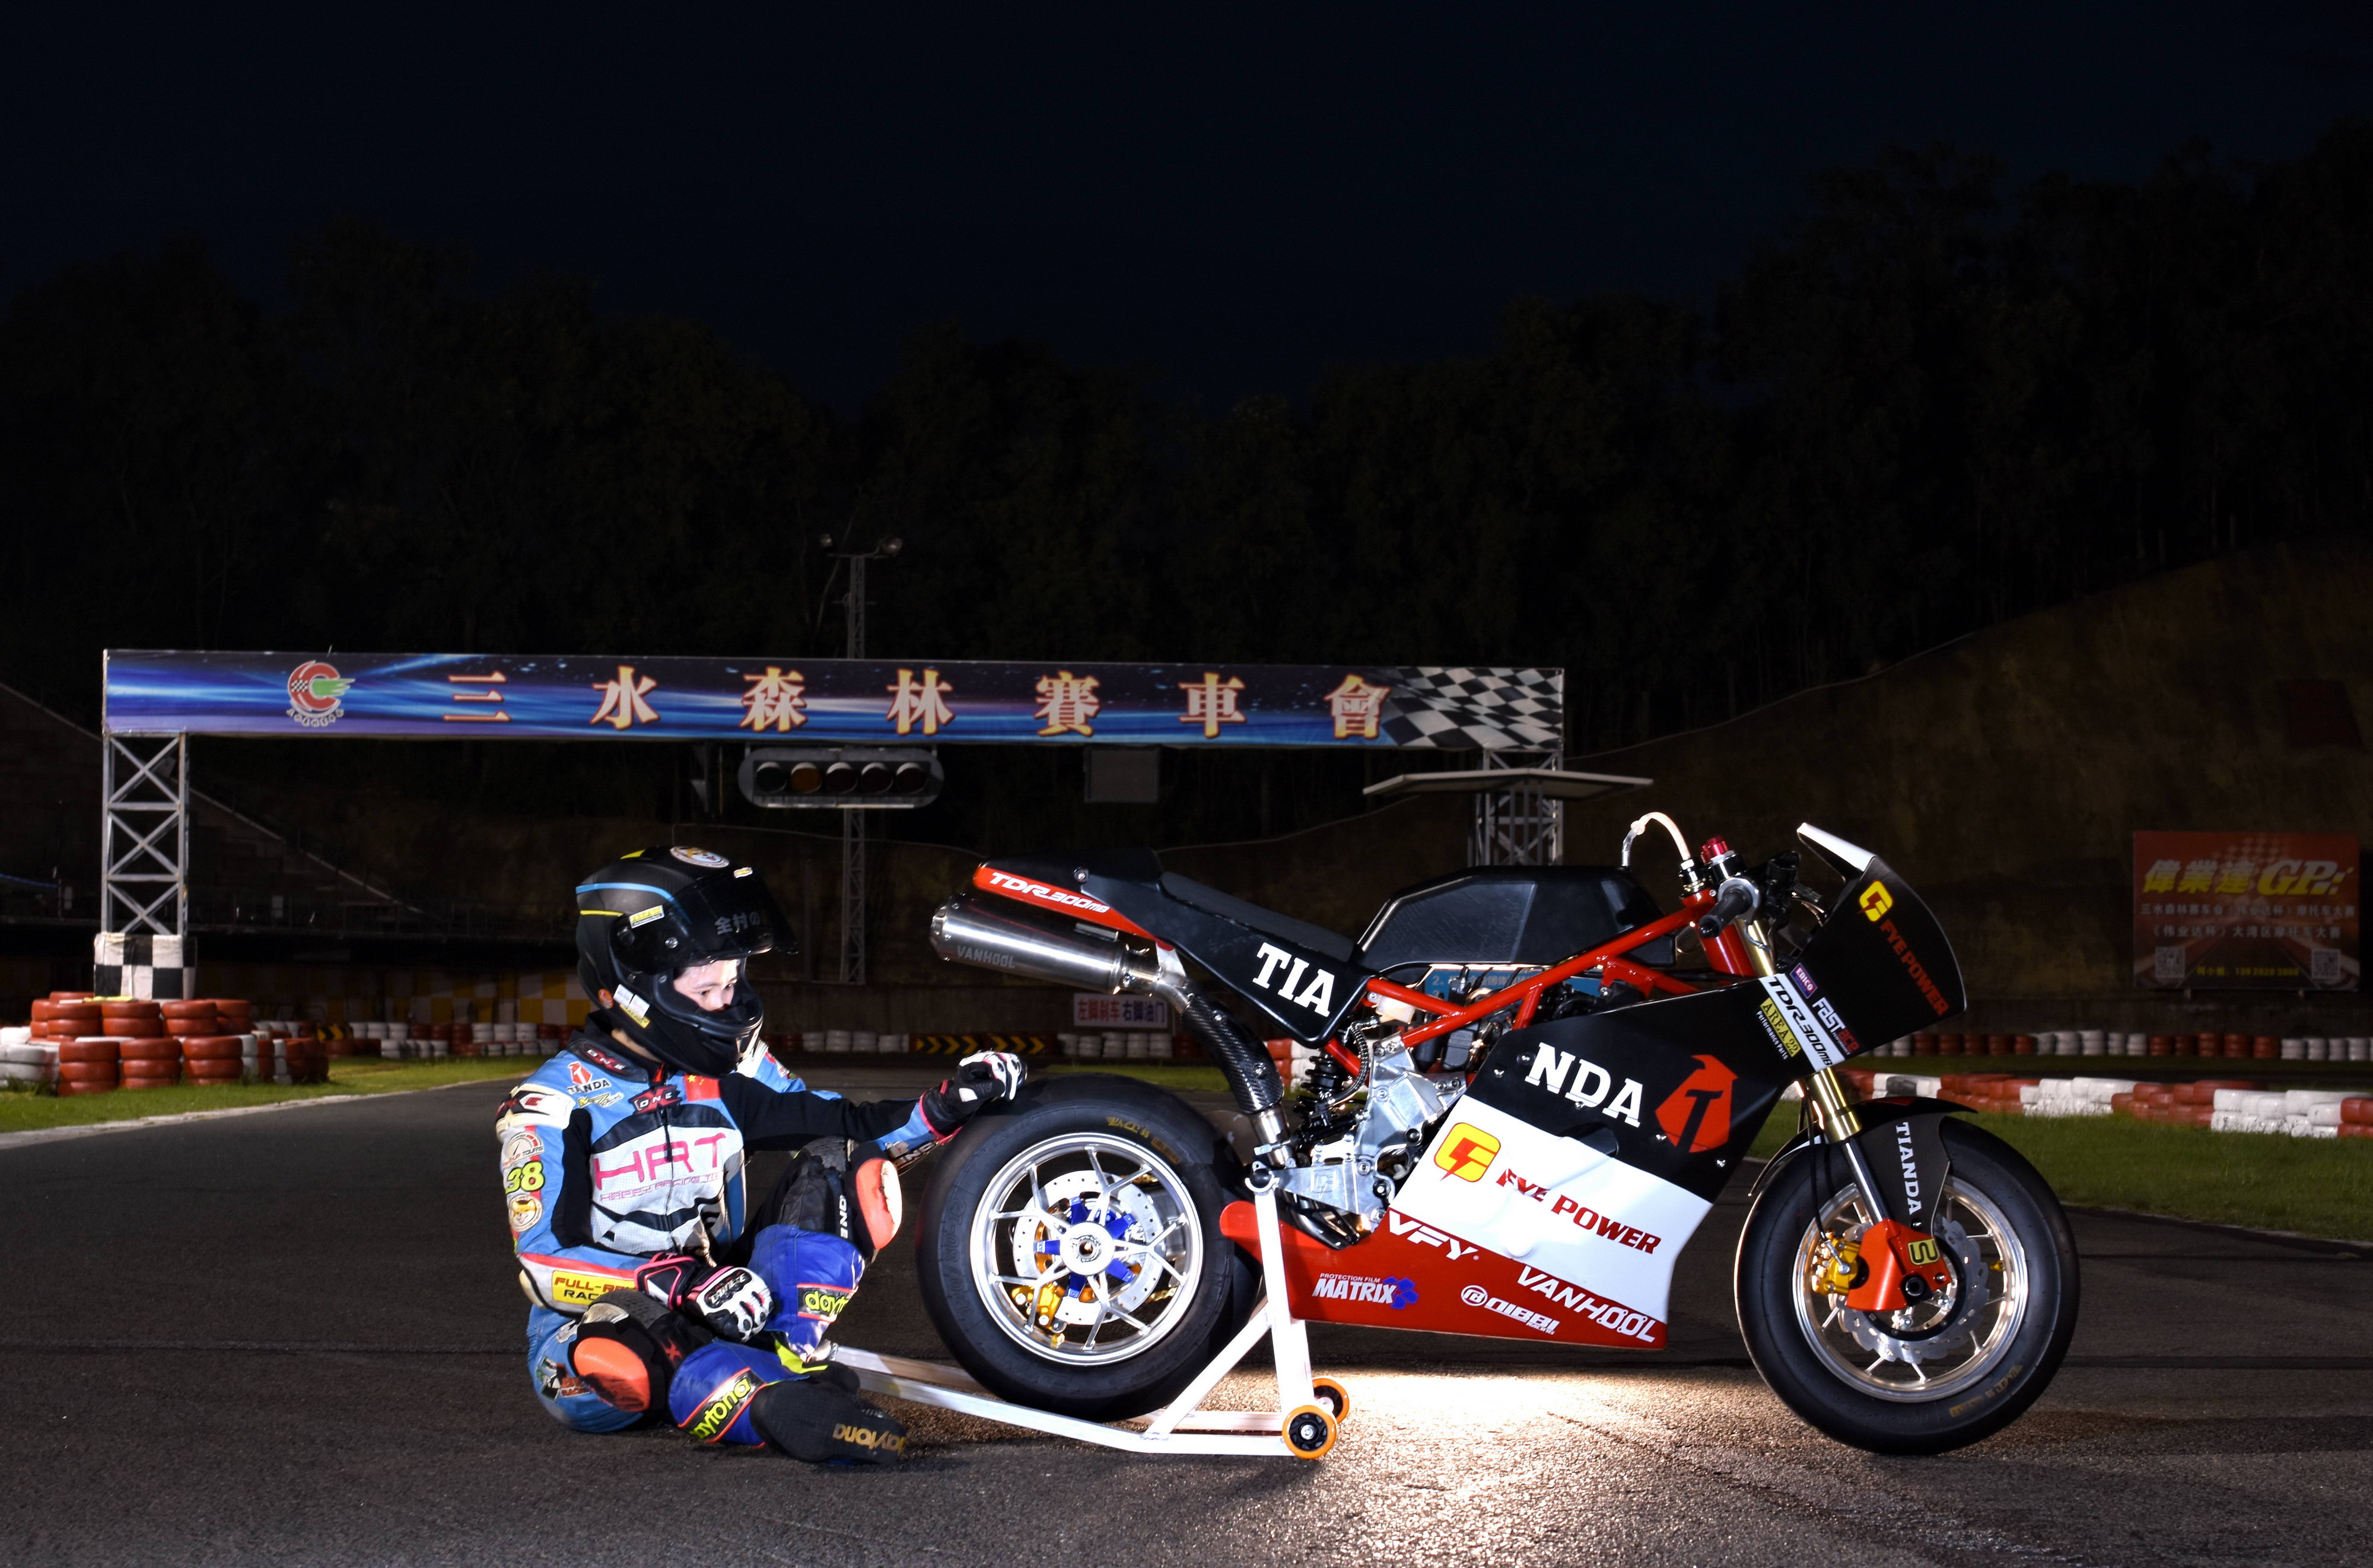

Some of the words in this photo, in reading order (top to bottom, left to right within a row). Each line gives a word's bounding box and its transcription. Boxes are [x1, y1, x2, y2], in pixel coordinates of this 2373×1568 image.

[444, 666, 1391, 738] 三水森林賽車會
[957, 945, 1016, 969] VANHOOL
[1252, 942, 1335, 1017] TIA
[1796, 968, 1813, 991] ERICO
[1879, 919, 1908, 955] FYE
[1900, 951, 1949, 1016] POWER
[1078, 998, 1120, 1021] 左脚刹车
[1123, 1000, 1165, 1023] 右脚油门
[1757, 1010, 1779, 1045] Performance
[1776, 1042, 1789, 1060] Parts
[1763, 1003, 1788, 1039] AREA
[1786, 1038, 1798, 1055] 22
[1525, 1042, 1643, 1127] NDA
[522, 1147, 543, 1156] TOURS
[594, 1132, 726, 1190] HRT
[1895, 1122, 1922, 1215] TIANDA
[505, 1161, 546, 1197] 38
[839, 1195, 848, 1239] ONE
[1551, 1194, 1662, 1254] POWER
[1312, 1278, 1397, 1304] MATRIX
[1320, 1273, 1363, 1281] PROTECTION
[1516, 1265, 1656, 1343] VANHOOL
